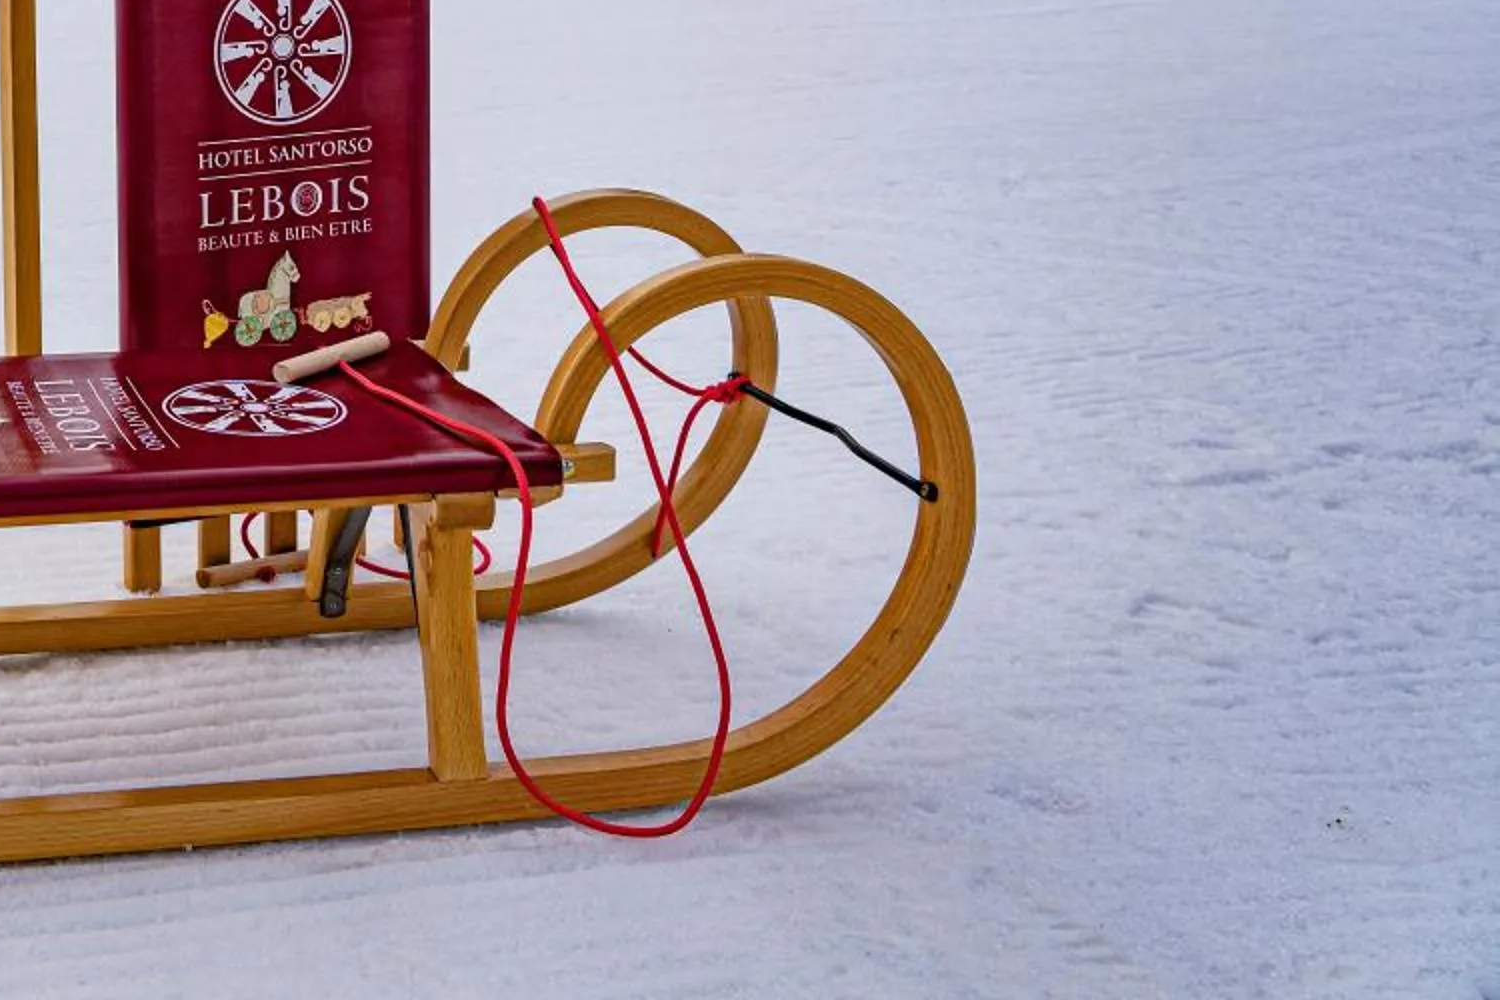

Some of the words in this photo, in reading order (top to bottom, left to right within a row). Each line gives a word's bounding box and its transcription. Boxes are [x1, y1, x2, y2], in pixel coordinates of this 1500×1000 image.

[198, 149, 264, 169] HOTEL
[270, 137, 373, 163] SANT'ORSO
[199, 175, 370, 229] LEBOIS
[198, 231, 264, 252] BEAUTE
[269, 230, 281, 243] &
[285, 223, 323, 241] BIEN
[329, 218, 373, 237] ETRE
[34, 380, 116, 451] LEBOIS
